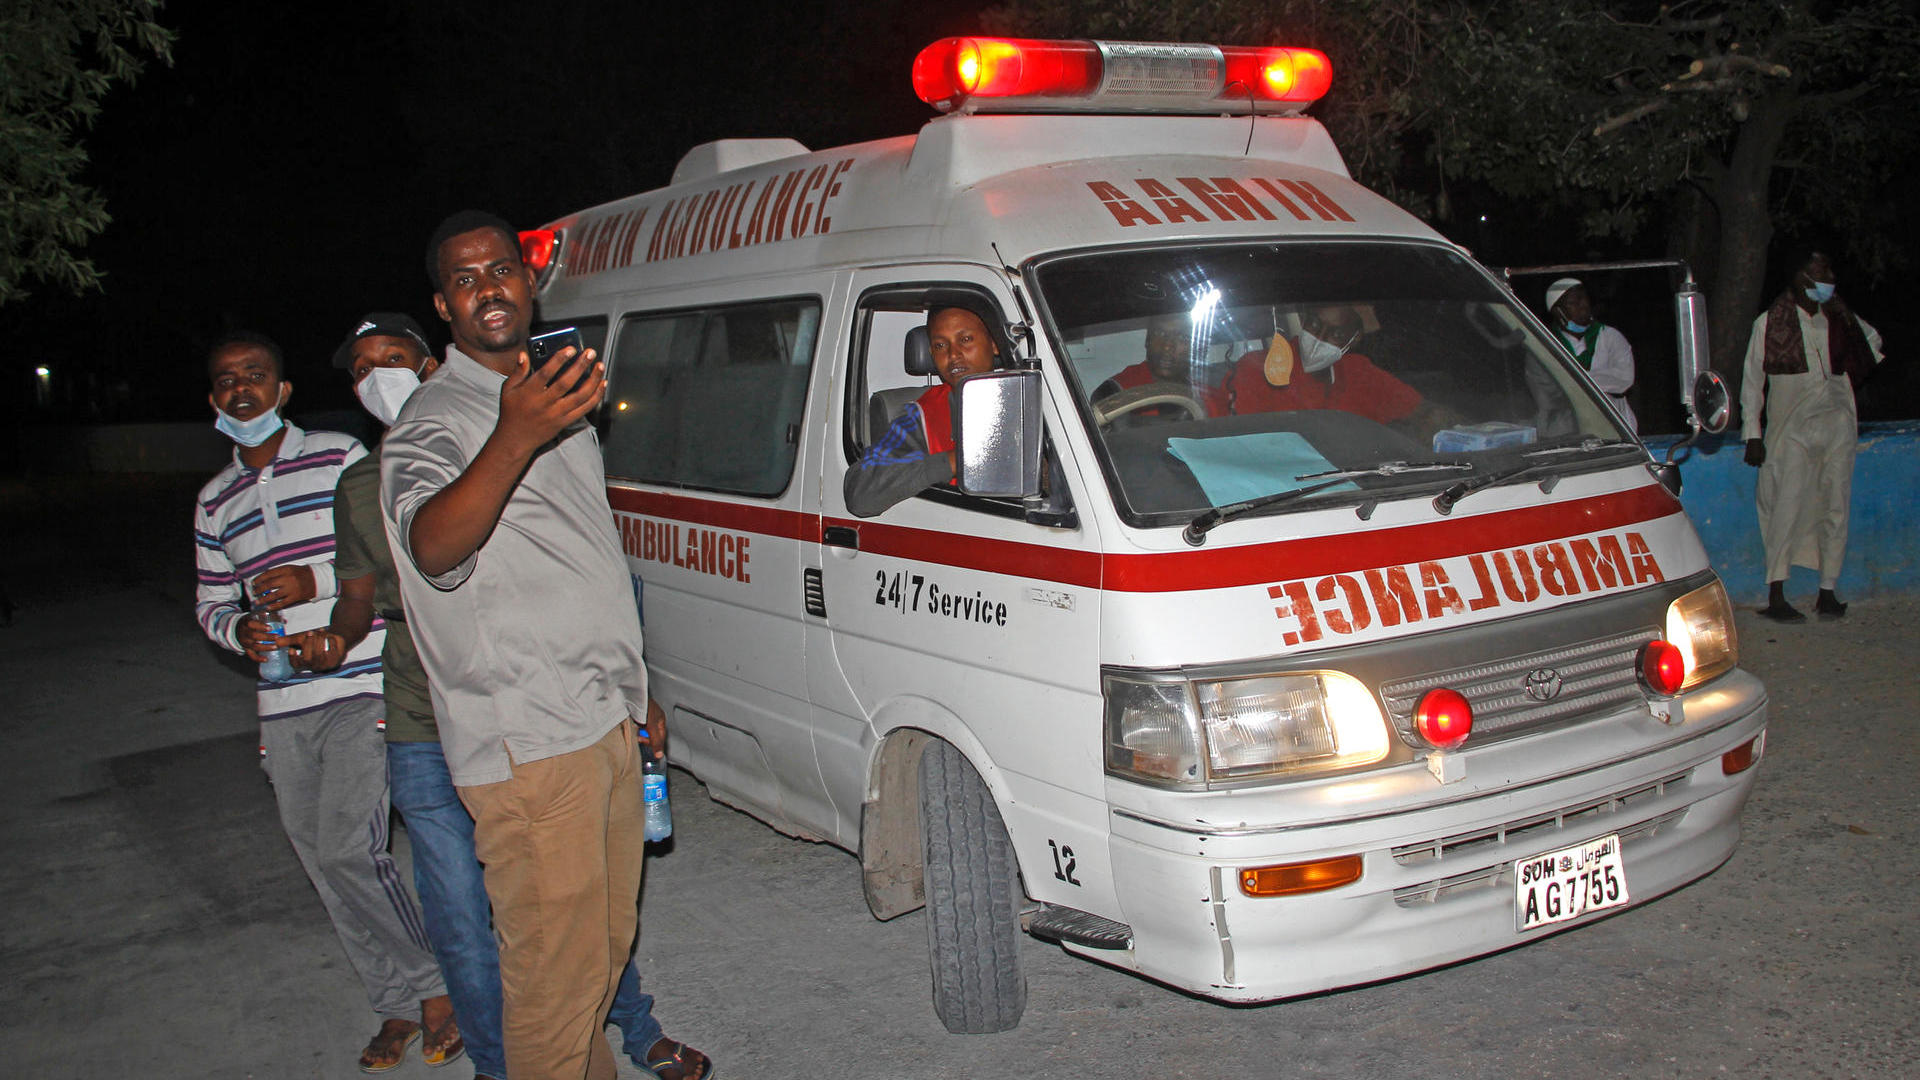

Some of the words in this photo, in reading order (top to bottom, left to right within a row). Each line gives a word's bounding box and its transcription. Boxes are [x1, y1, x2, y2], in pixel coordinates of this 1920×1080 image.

[646, 158, 855, 263] AMBULANCE
[1086, 177, 1357, 227] AAMIN
[928, 583, 1008, 627] Service
[1048, 839, 1081, 887] 12
[1522, 857, 1555, 885] SOM
